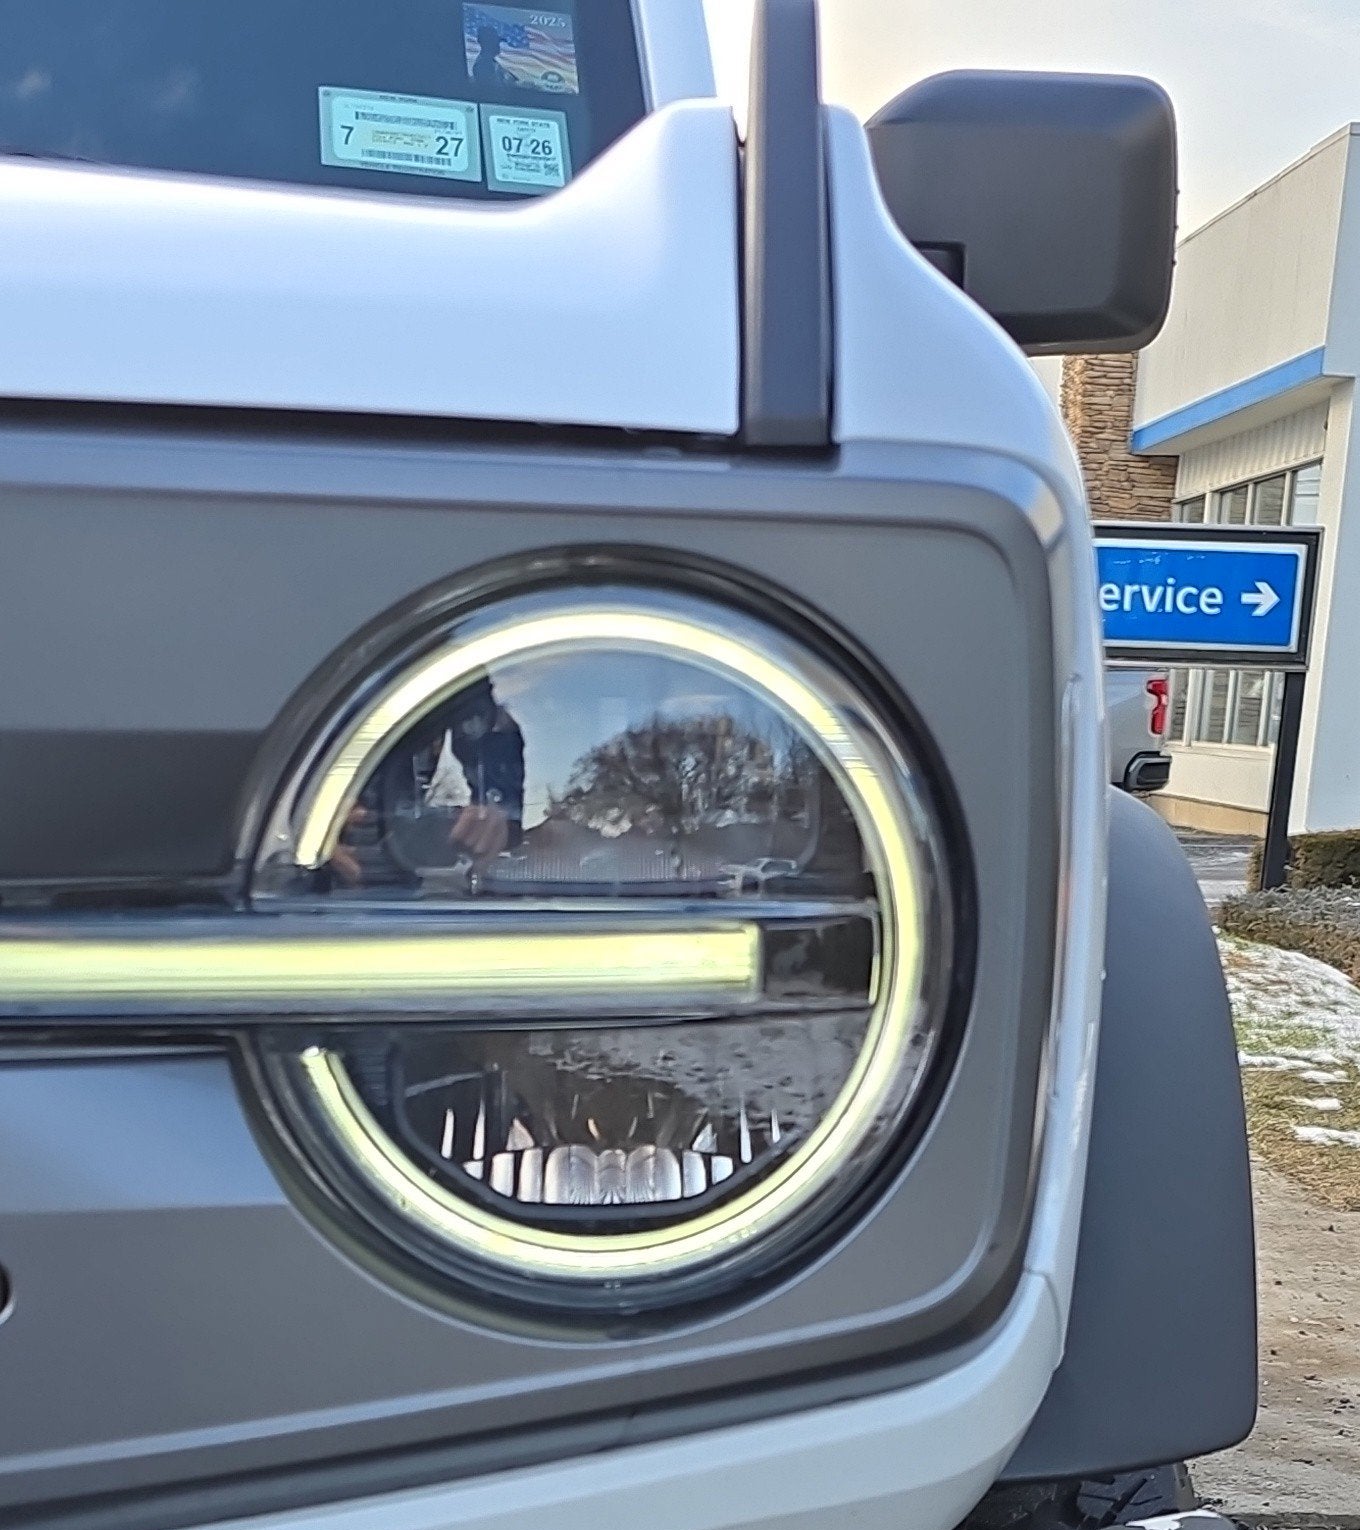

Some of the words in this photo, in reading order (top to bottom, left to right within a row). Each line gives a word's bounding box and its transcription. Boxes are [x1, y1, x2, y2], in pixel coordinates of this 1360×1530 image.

[340, 125, 354, 145] 7
[435, 136, 464, 157] 27
[1098, 577, 1224, 615] ervice
